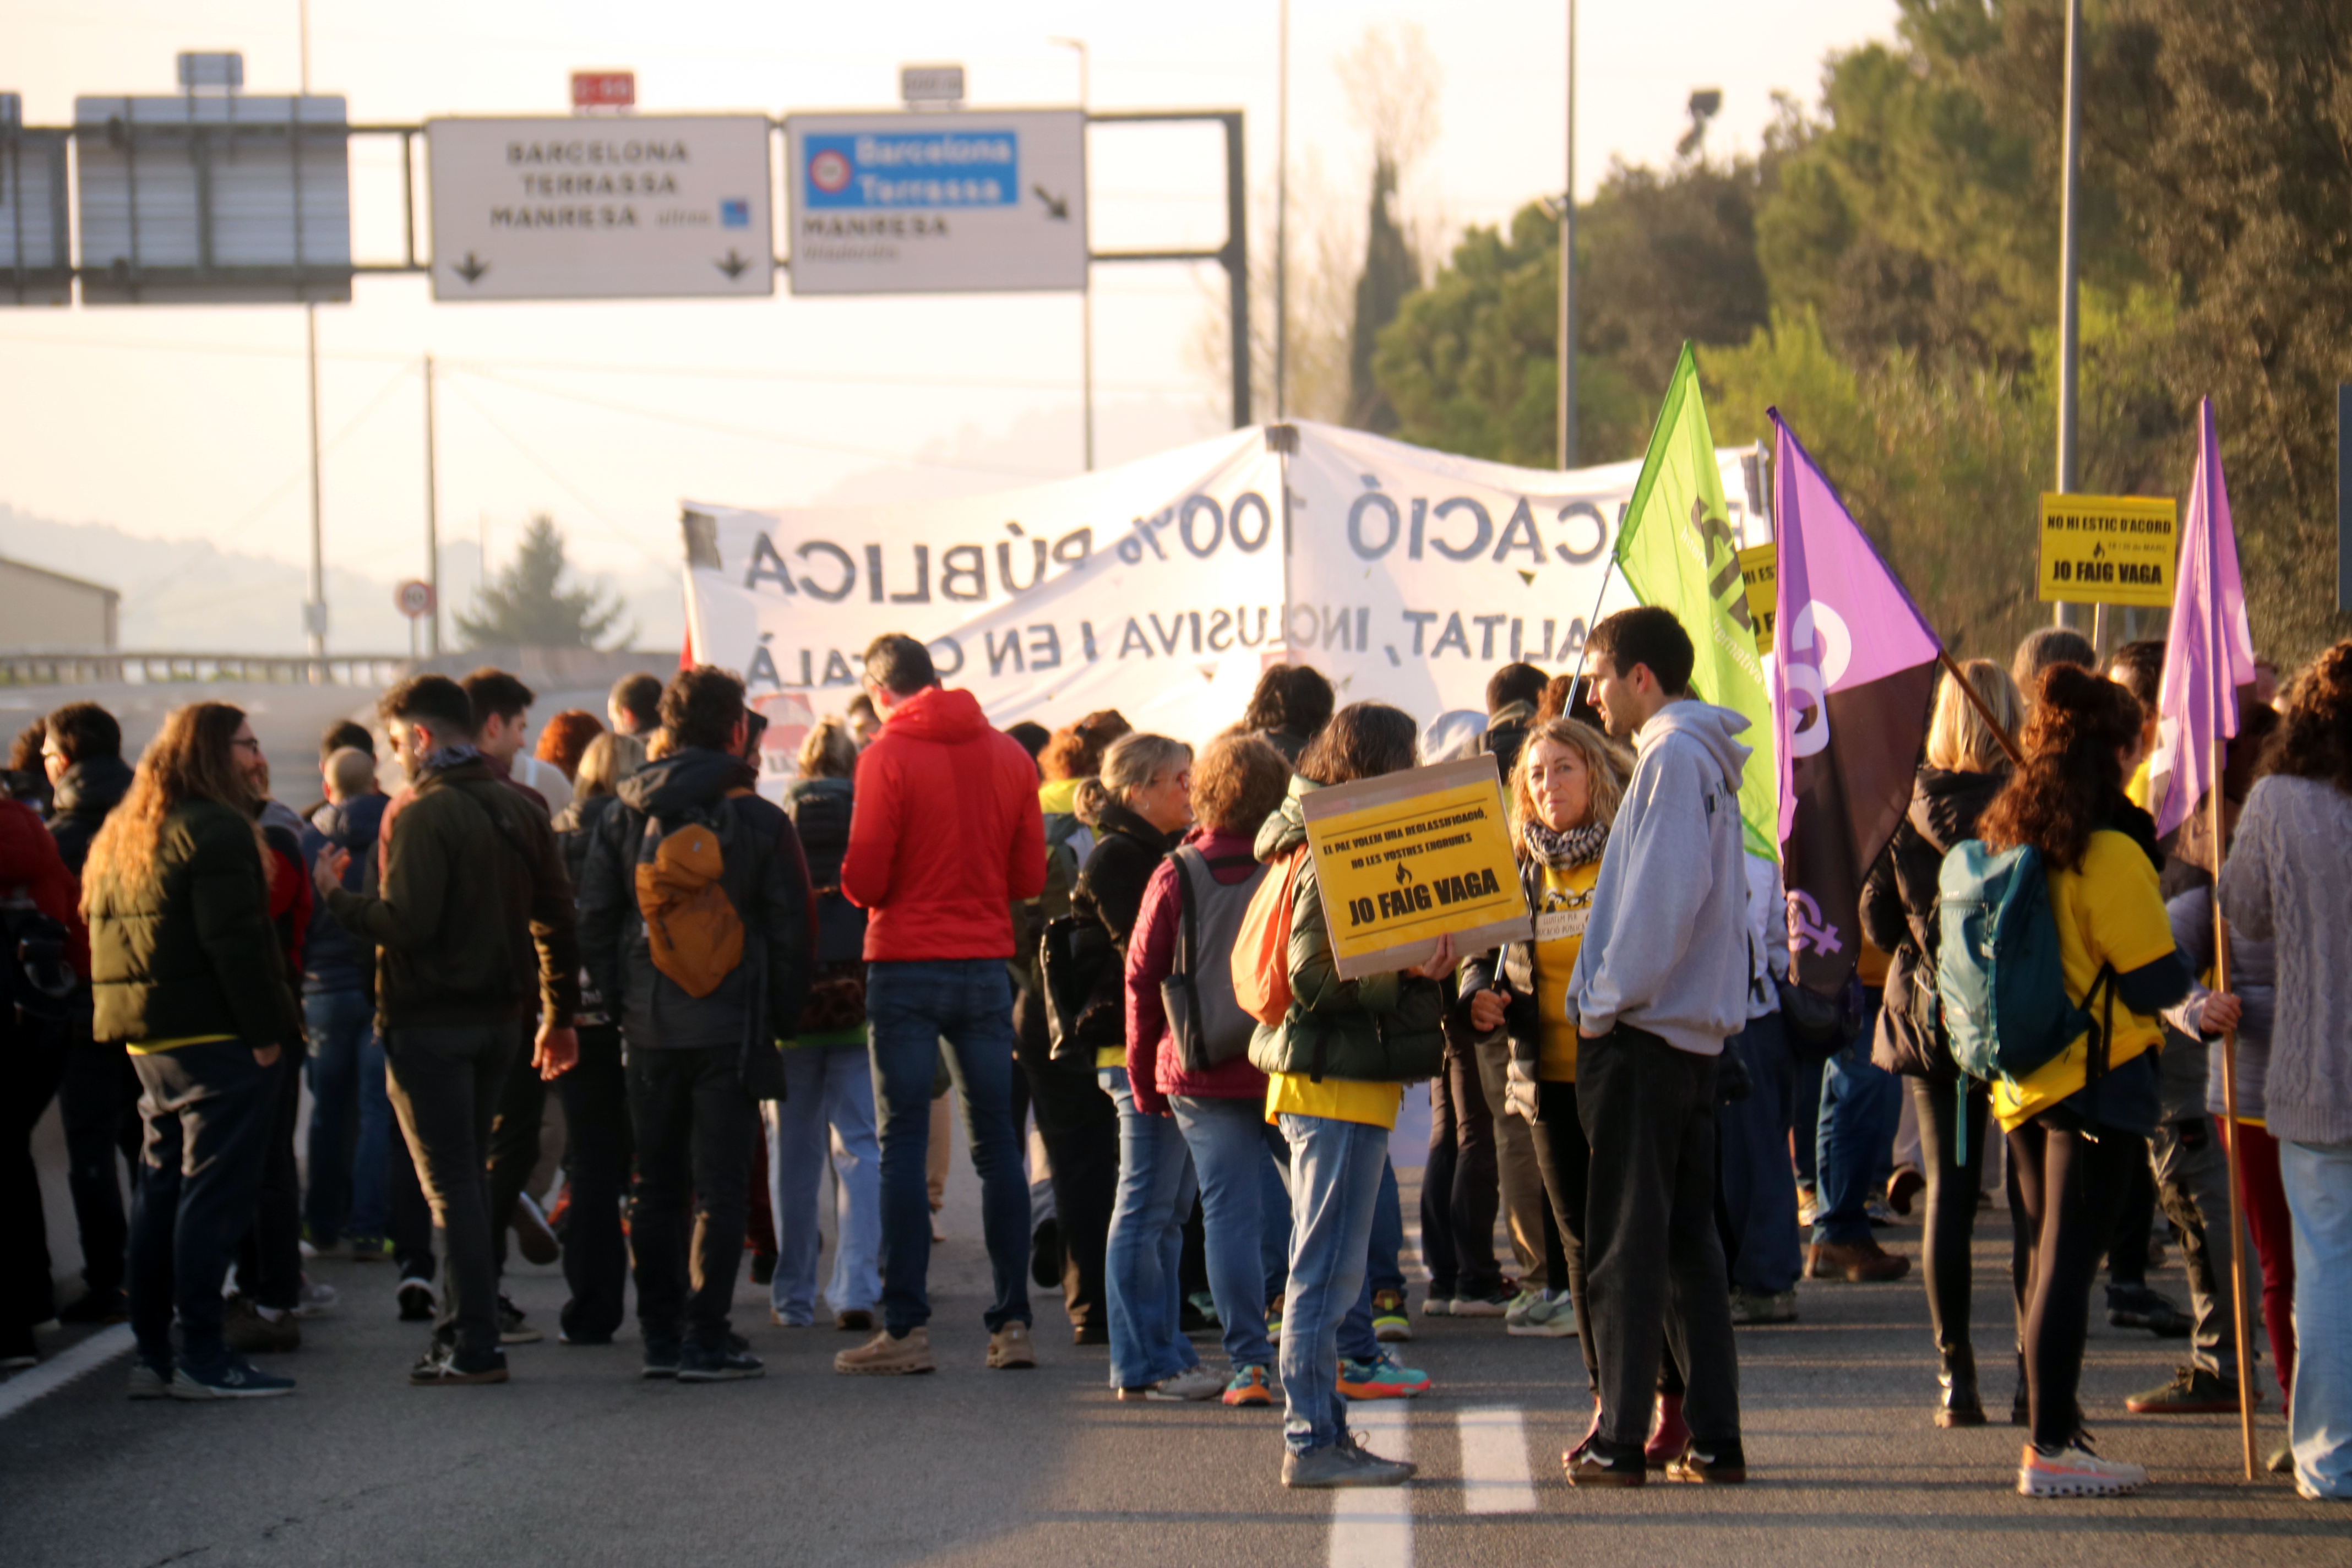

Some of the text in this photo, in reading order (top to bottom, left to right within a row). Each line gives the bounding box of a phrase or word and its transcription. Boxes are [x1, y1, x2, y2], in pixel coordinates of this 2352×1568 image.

[507, 141, 689, 165] BARCELONA
[856, 137, 1011, 164] Barcelona
[522, 173, 679, 196] TERRASSA
[489, 206, 639, 228] MANRESA
[803, 215, 949, 237] MANRESA
[2048, 515, 2171, 535] NO HI ESTIC D'ACORD
[2052, 560, 2163, 585] JO FAIG VAGA
[1323, 845, 1333, 856] EL
[1353, 832, 1383, 850] VOLEM
[1384, 827, 1403, 841] UNA
[1405, 806, 1488, 837] RECLASSIFICACIÓ,
[1351, 832, 1473, 869] NO LES VOSTRES ENGRUNES
[1349, 868, 1500, 927] JO FAIG VAGA
[1567, 913, 1577, 922] PER
[1536, 925, 1560, 937] DUCACIÓ
